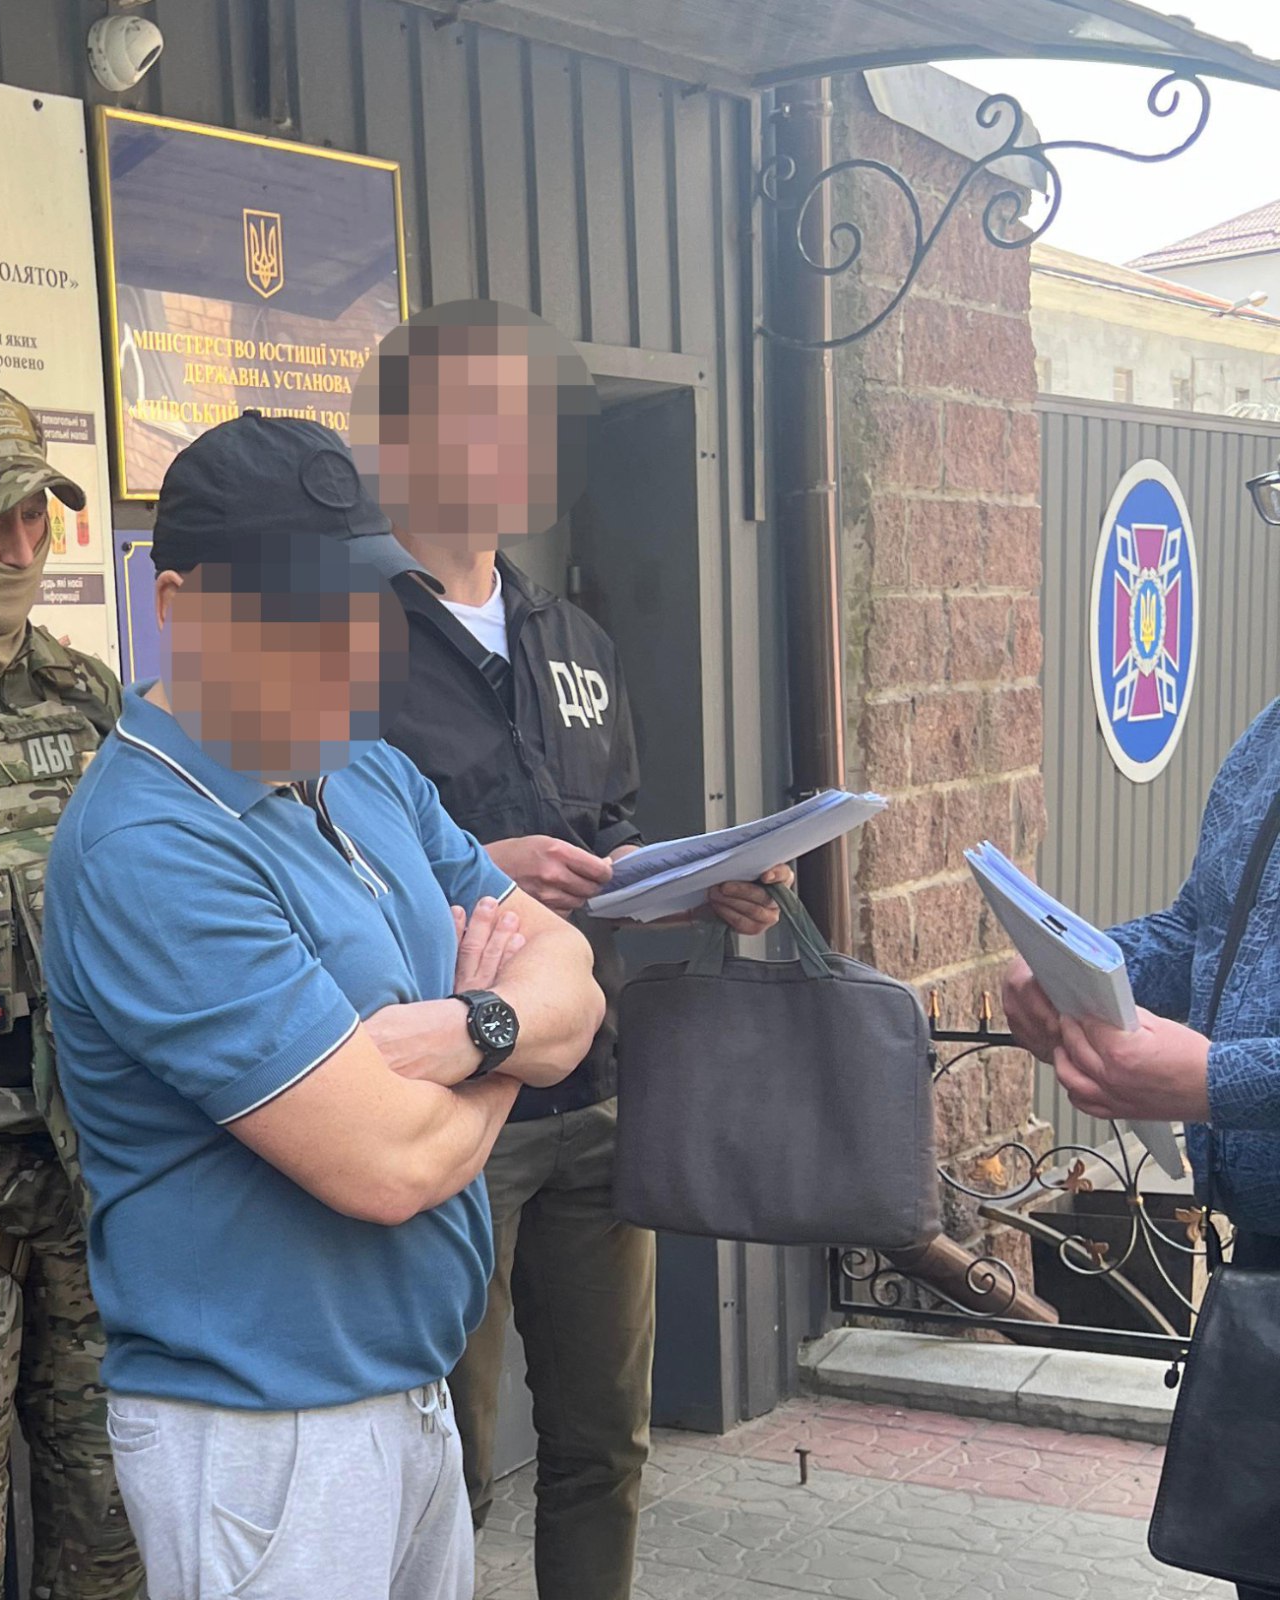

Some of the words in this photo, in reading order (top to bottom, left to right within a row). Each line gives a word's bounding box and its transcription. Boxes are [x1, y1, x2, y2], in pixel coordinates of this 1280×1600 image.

[5, 333, 38, 349] яких
[133, 329, 256, 360] МІНІСТЕРСТВО
[259, 340, 327, 368] ЮСТИЦІЇ
[183, 361, 271, 389] ДЕРЖАВНА
[272, 369, 352, 394] УСТАНОВА
[40, 579, 56, 590] удь
[27, 733, 75, 777] ДБР
